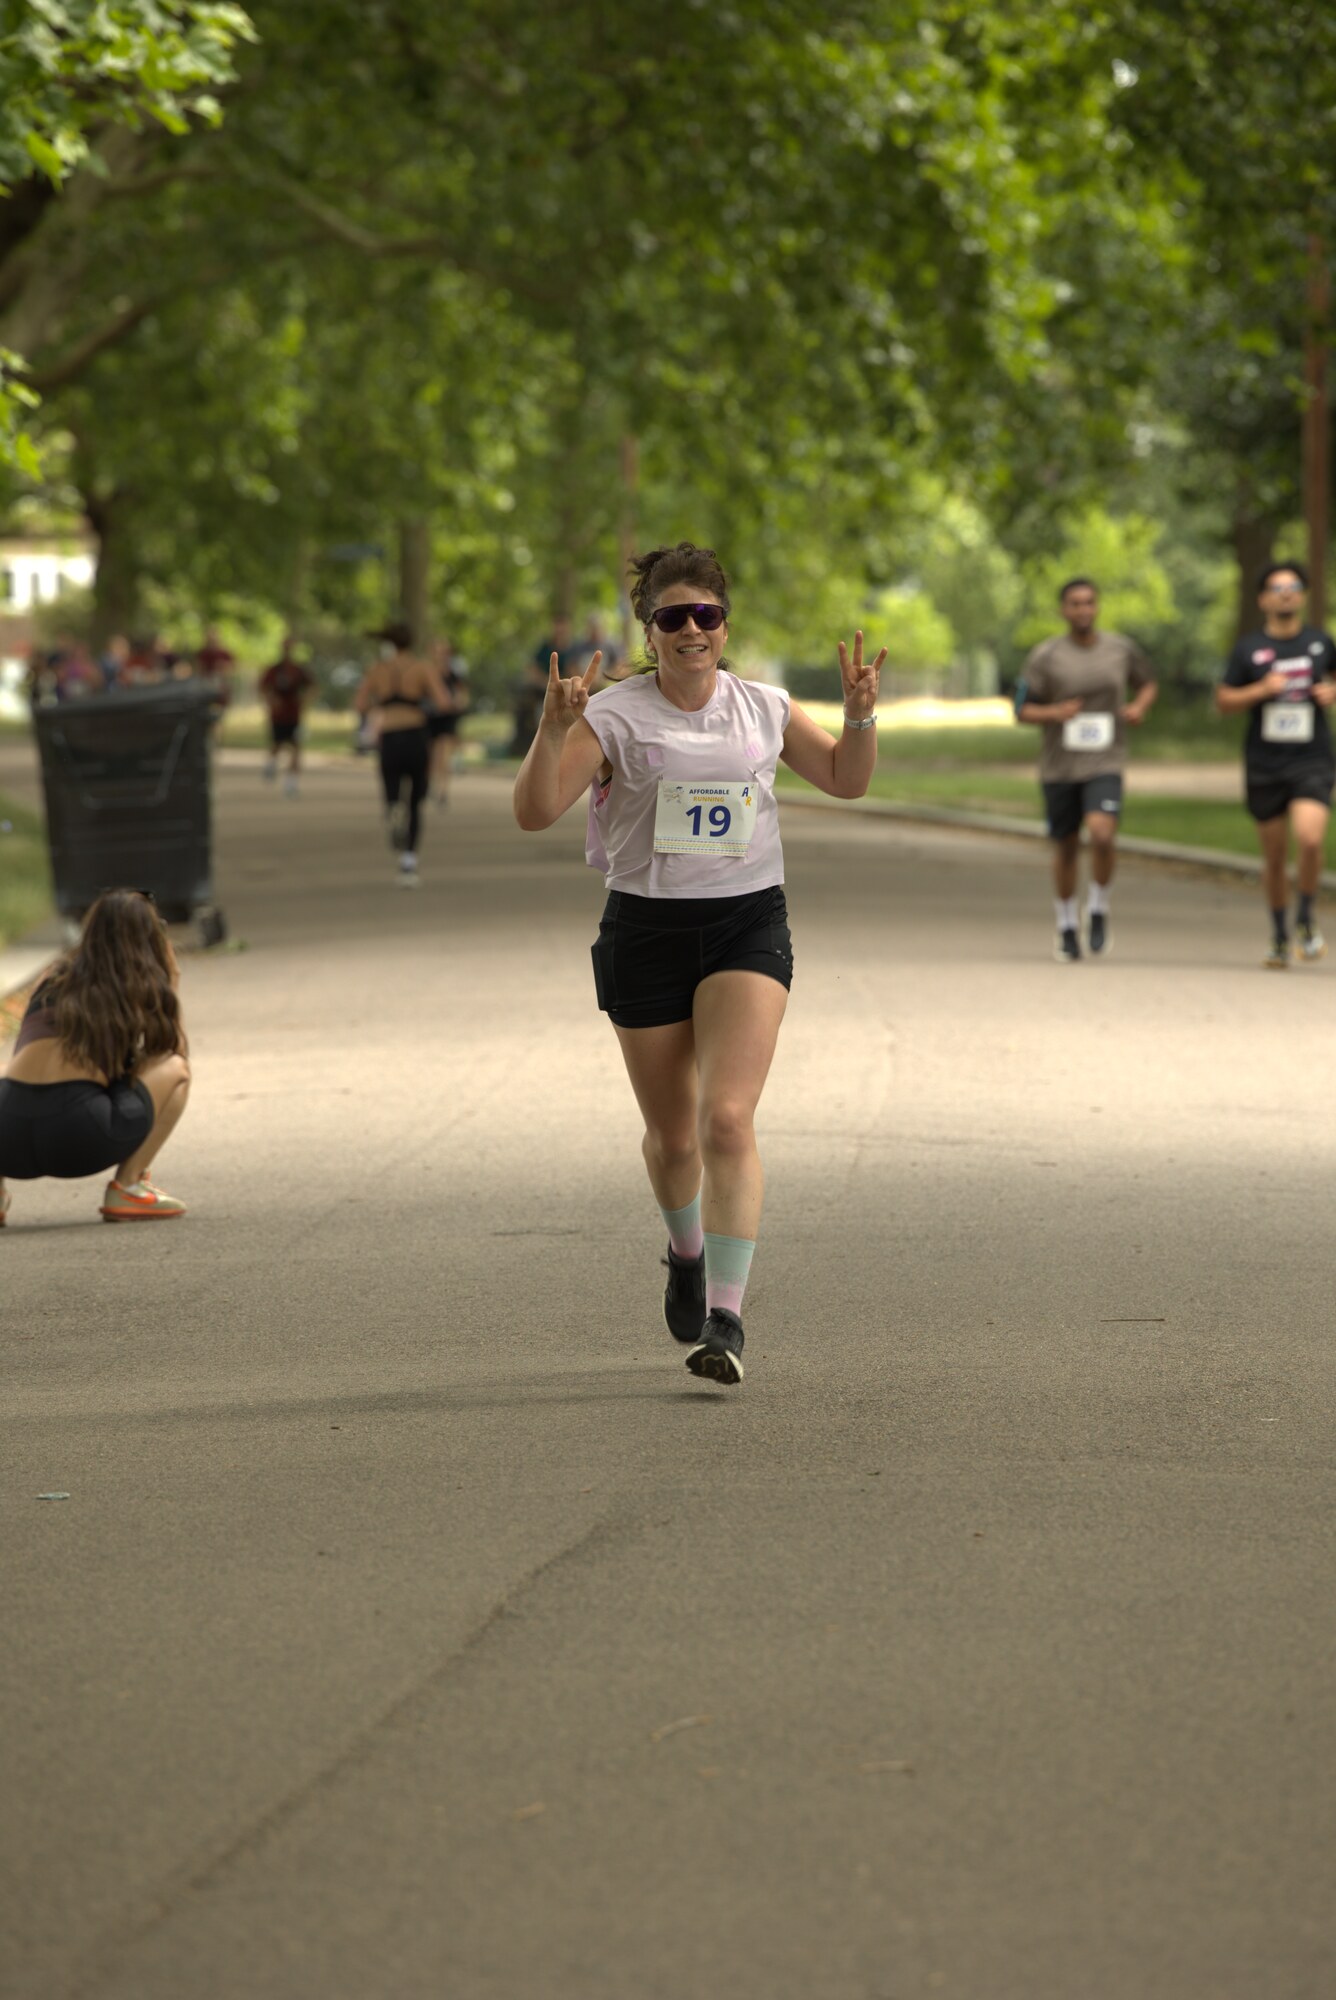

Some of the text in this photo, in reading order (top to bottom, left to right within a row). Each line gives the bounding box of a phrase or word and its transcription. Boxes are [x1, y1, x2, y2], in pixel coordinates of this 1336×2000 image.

[742, 787, 749, 797] A
[745, 796, 752, 806] R
[685, 805, 731, 837] 19
